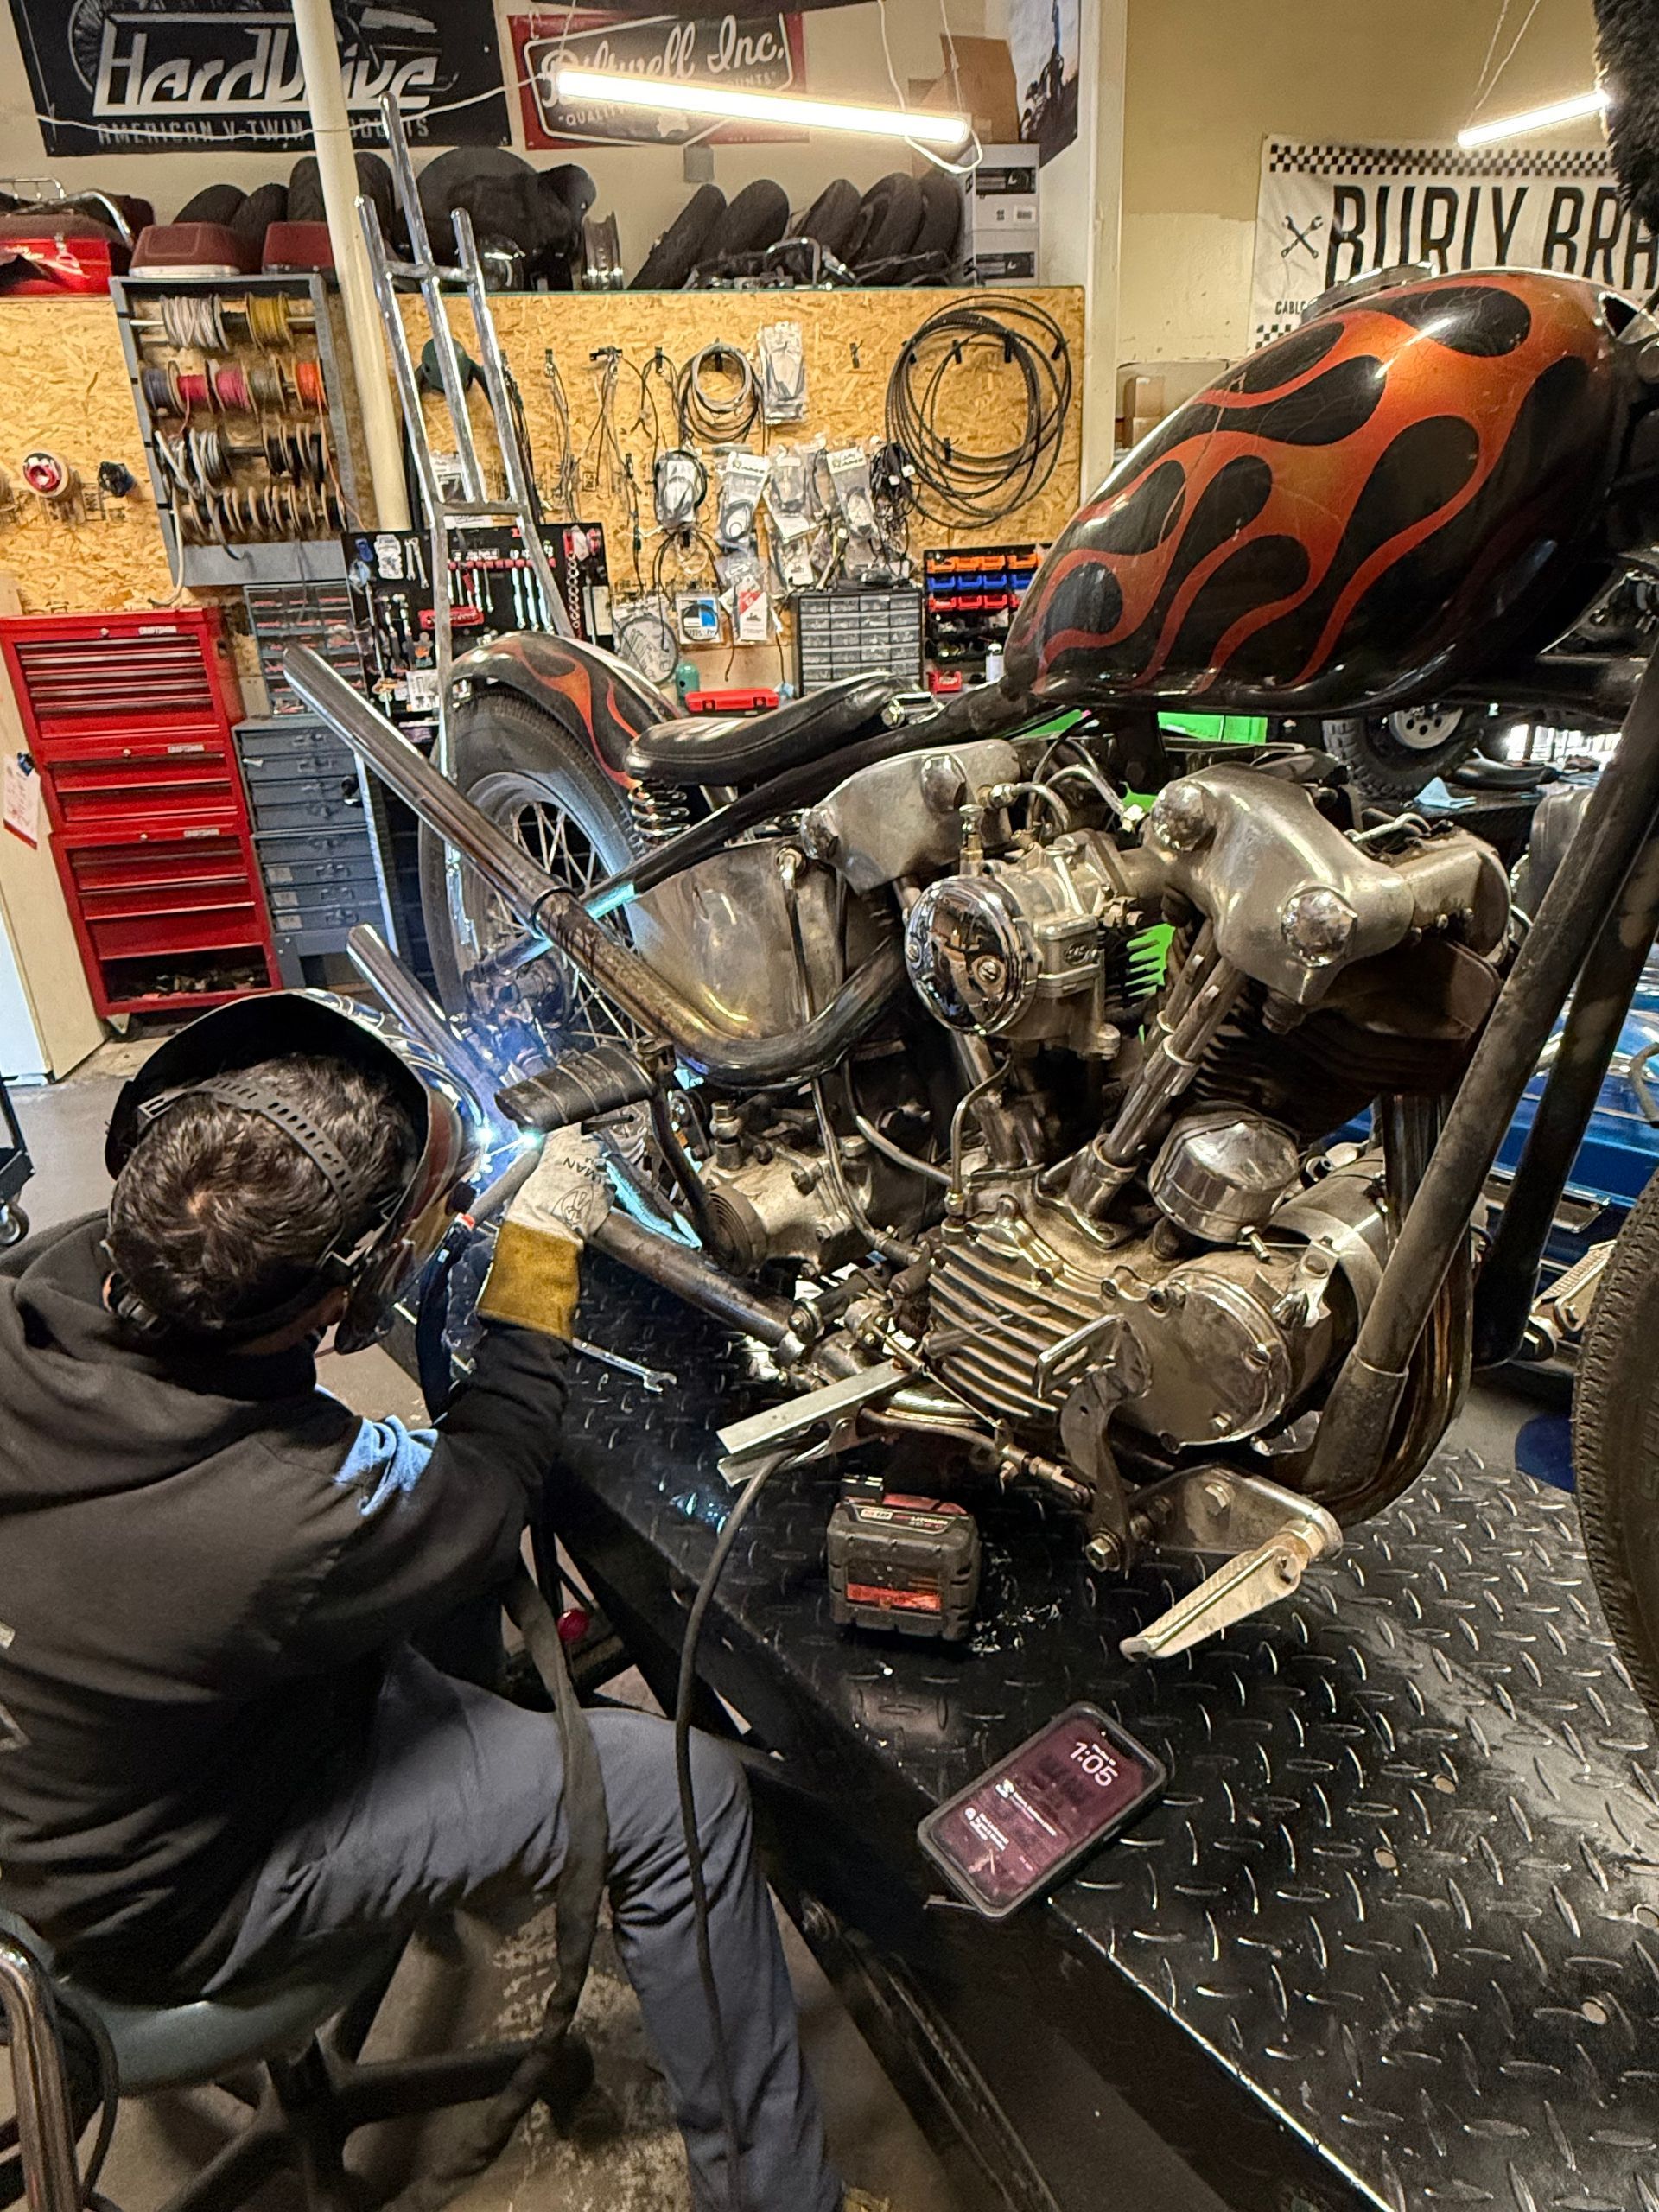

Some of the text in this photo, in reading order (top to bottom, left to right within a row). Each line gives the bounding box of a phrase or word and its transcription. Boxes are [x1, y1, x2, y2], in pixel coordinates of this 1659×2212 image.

[93, 17, 438, 116] HardDive
[707, 14, 785, 73] Inc.
[97, 120, 212, 145] AMERICAN
[1325, 184, 1529, 289] BURLY
[1070, 1741, 1119, 1787] 1:05
